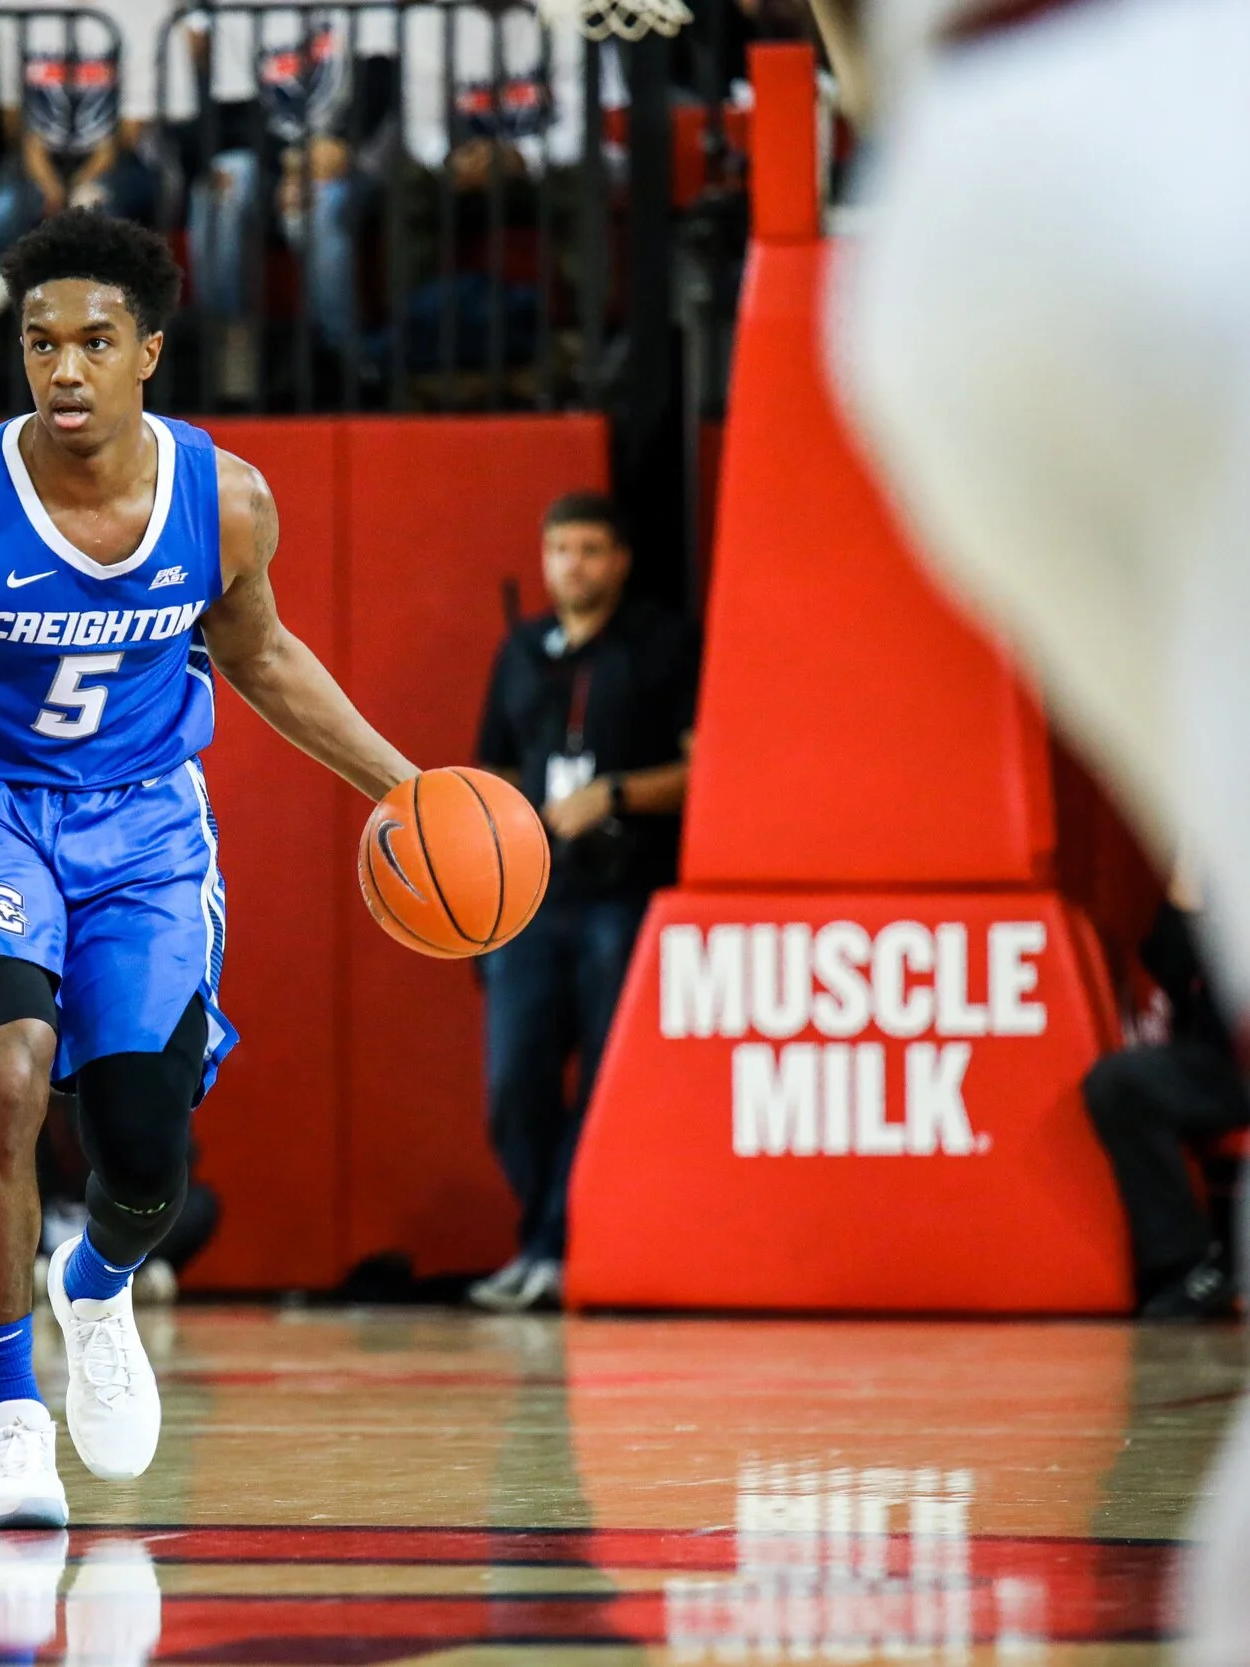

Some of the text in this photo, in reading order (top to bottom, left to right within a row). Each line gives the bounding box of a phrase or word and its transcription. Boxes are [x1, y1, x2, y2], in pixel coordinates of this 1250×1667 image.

[150, 572, 189, 587] EAST
[157, 566, 183, 577] BIG
[30, 651, 126, 740] 5
[660, 919, 1047, 1039] MUSCLE
[732, 1042, 975, 1157] MILK
